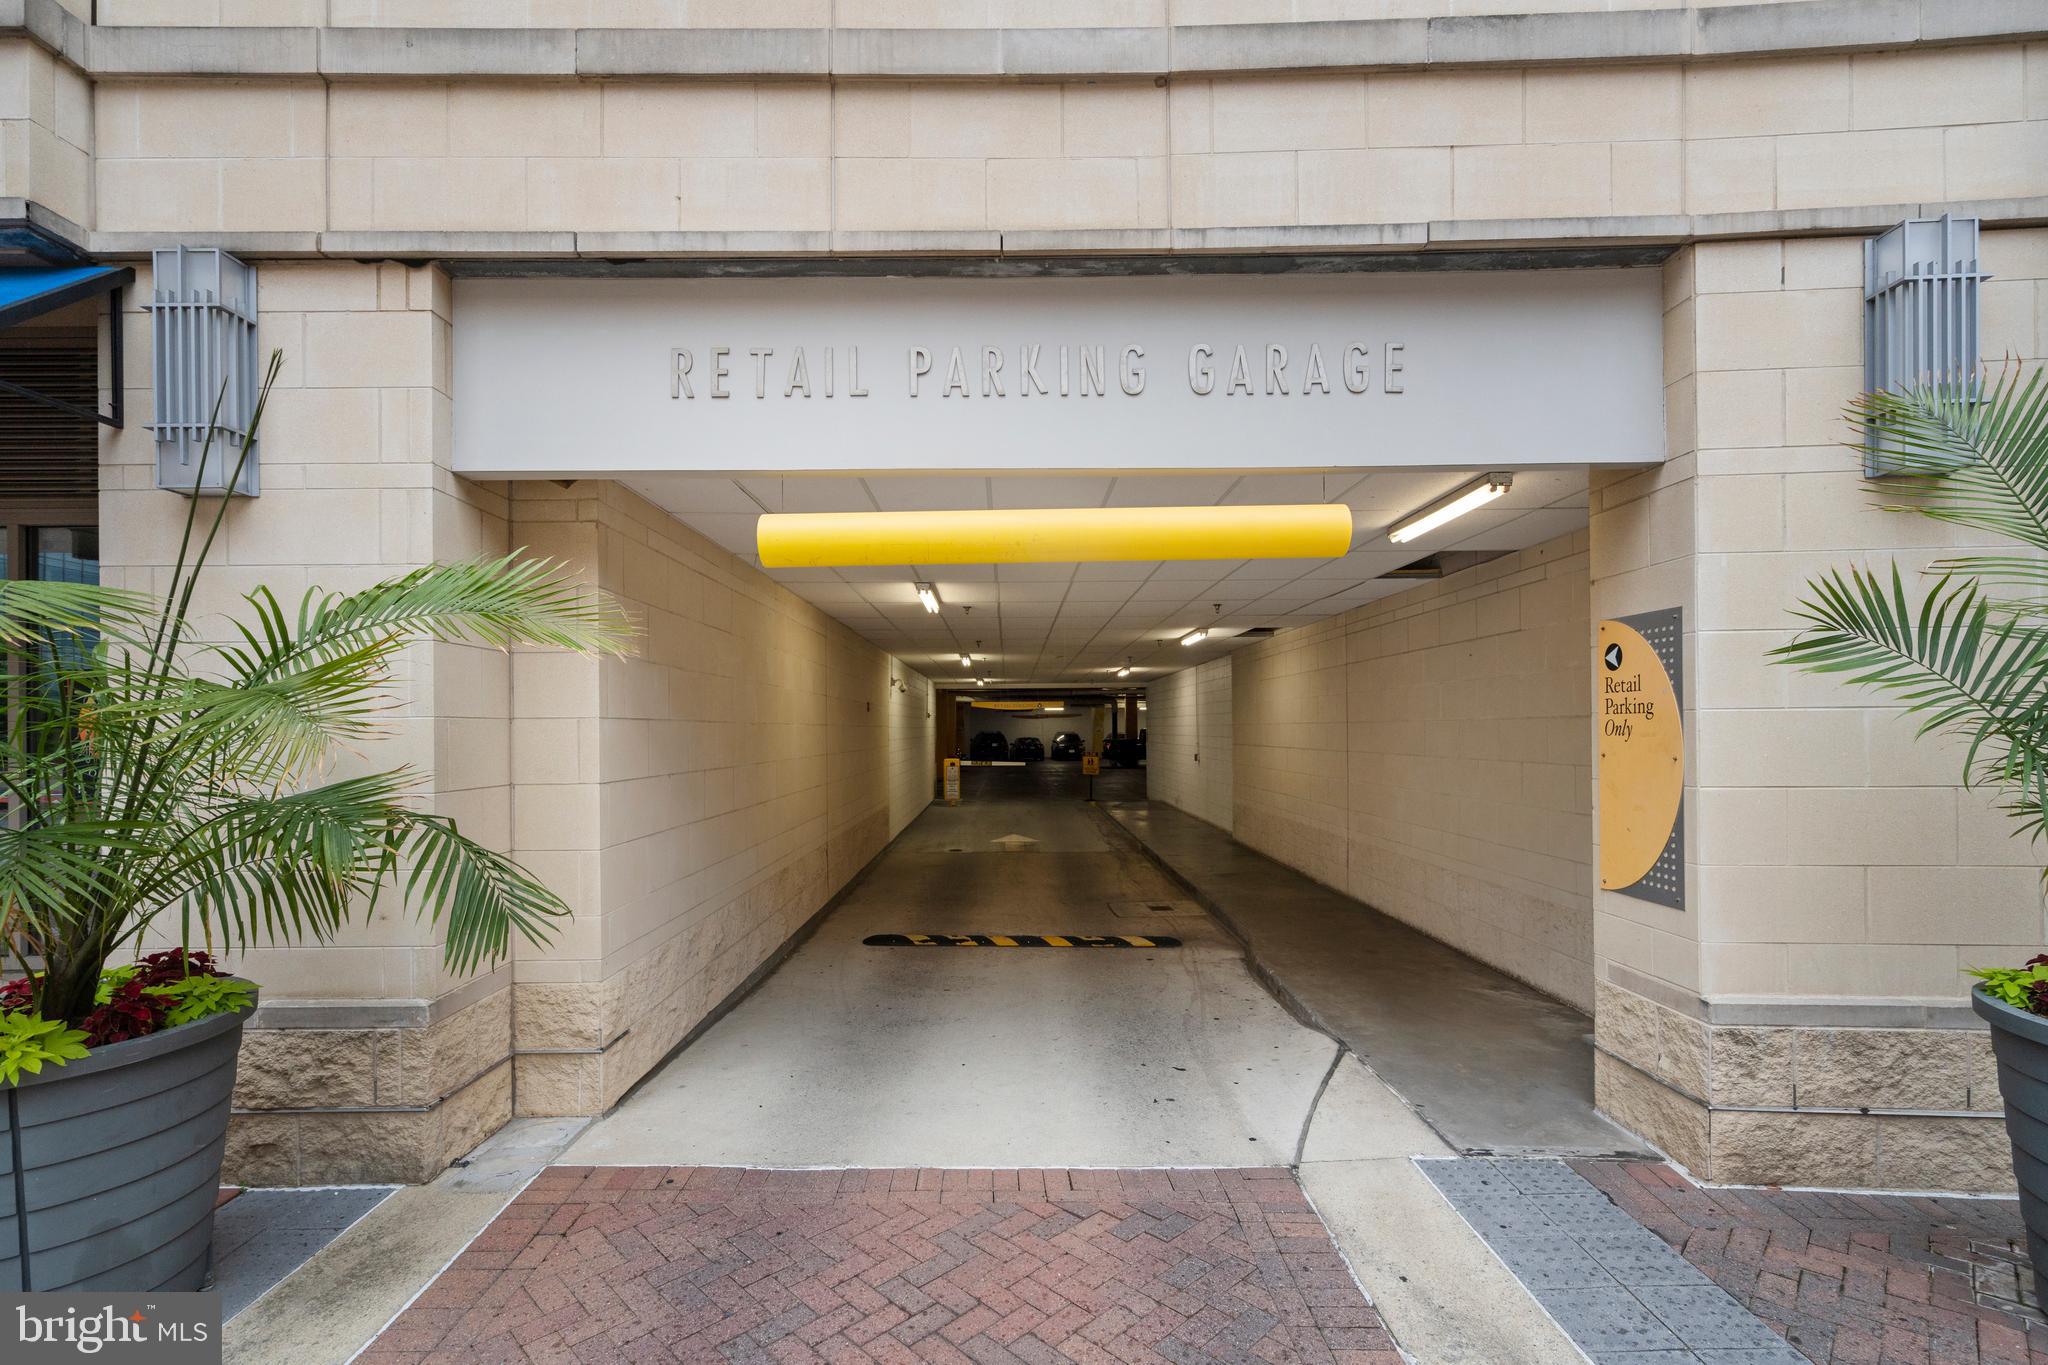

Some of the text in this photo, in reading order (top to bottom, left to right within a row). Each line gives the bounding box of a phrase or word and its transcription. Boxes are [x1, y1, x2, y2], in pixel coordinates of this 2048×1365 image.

[671, 342, 1405, 399] RETAIL PARKING GARAGE
[1604, 674, 1642, 694] Retail
[1604, 697, 1655, 720] Parking
[1604, 719, 1633, 742] Only
